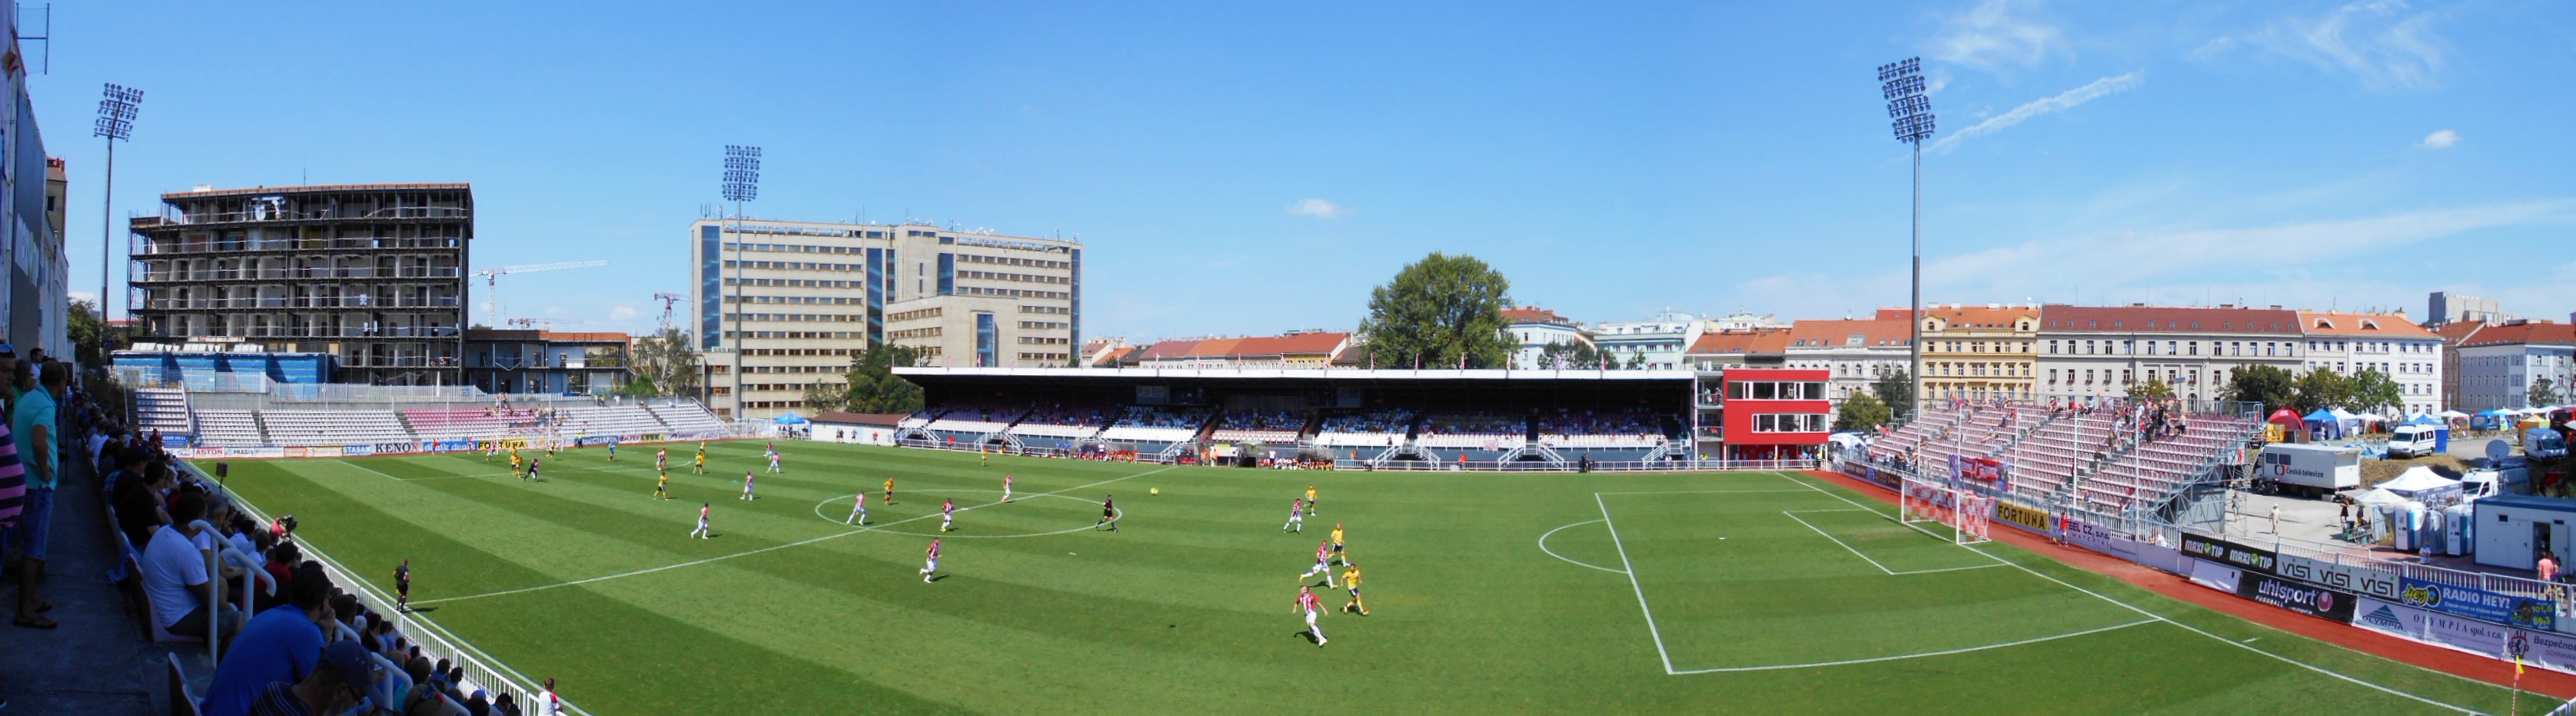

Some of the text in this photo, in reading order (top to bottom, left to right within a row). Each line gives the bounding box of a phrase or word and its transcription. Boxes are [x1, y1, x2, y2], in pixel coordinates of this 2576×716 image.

[2302, 469, 2324, 478] televize
[1997, 505, 2045, 530] FORTUNA
[2185, 540, 2273, 569] MAXI TIP MAXI TIP
[2255, 594, 2284, 608] FUSSBALL
[2259, 578, 2316, 607] uhlsport
[2443, 588, 2510, 609] RADIO HEY!
[2362, 615, 2403, 631] OLYMPIA
